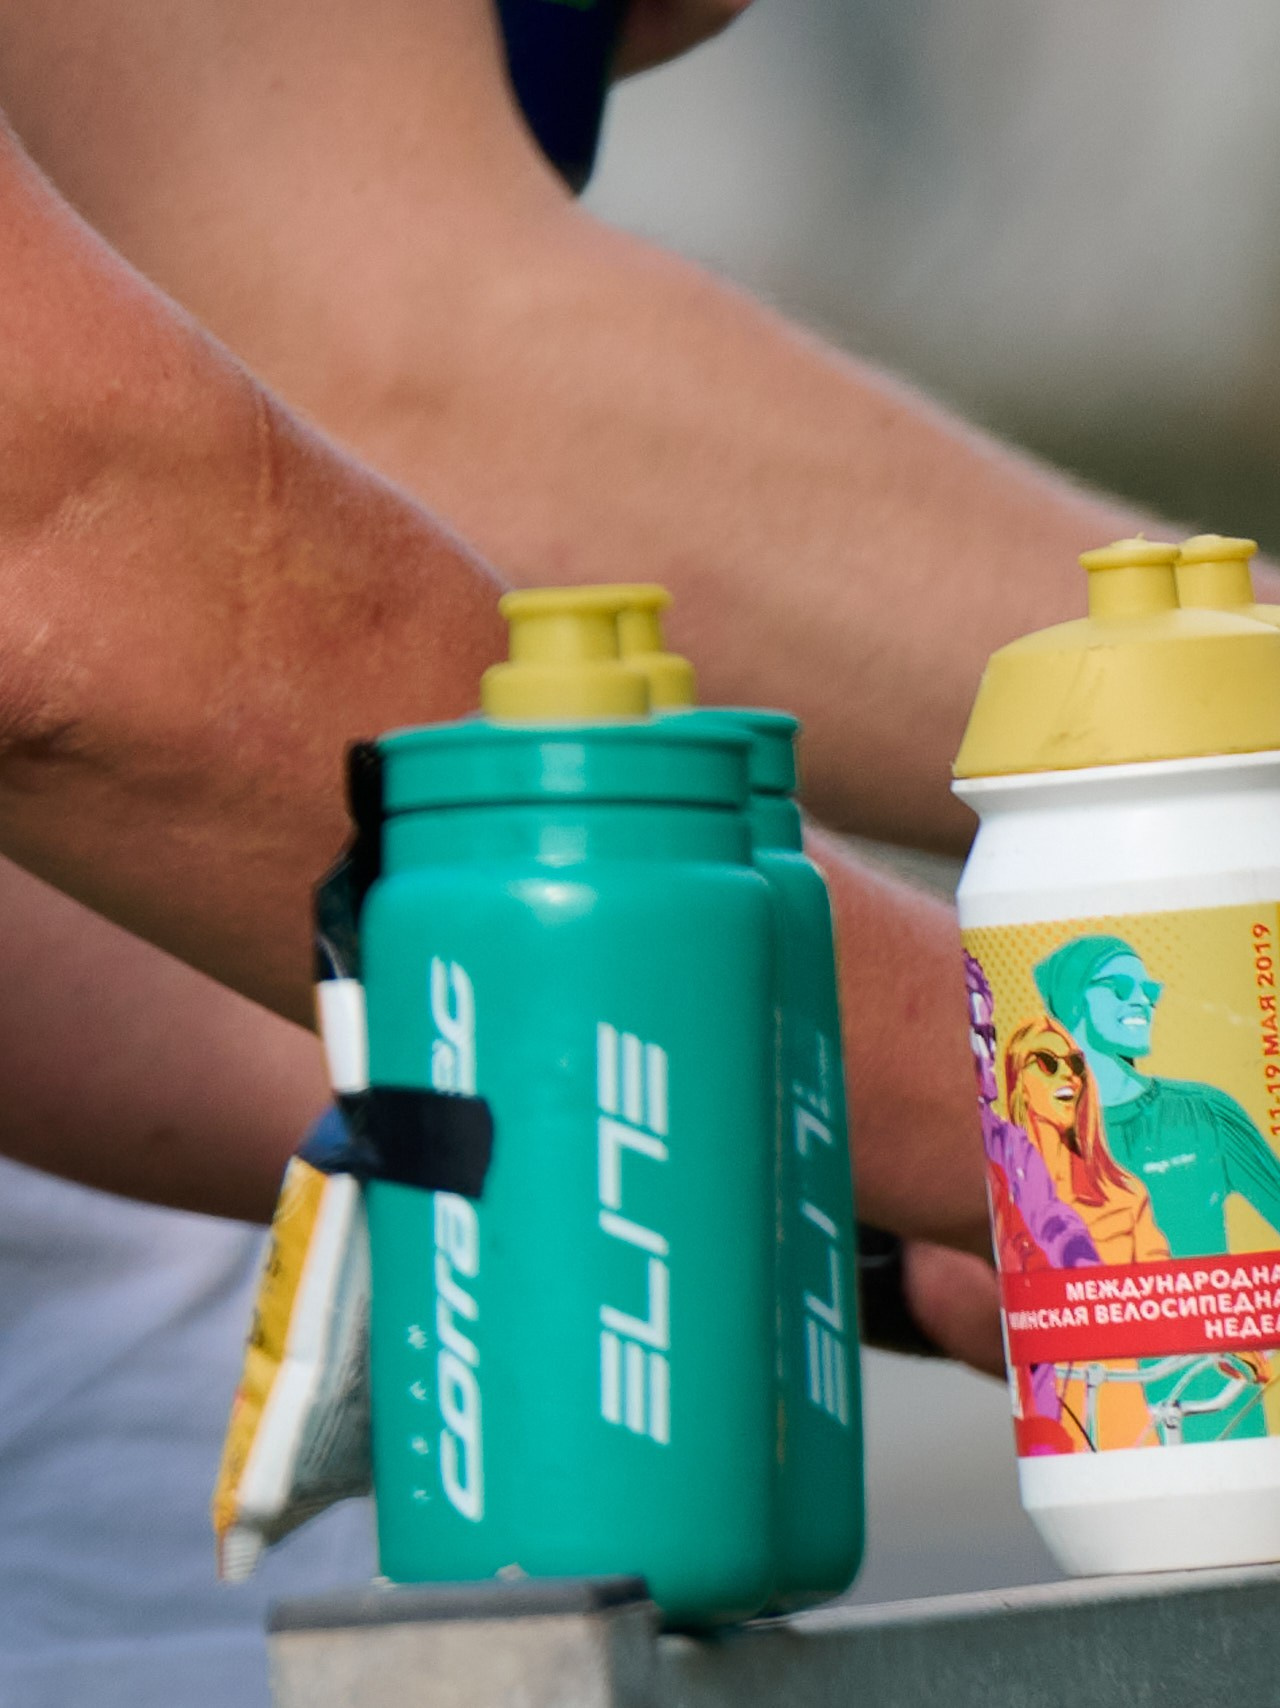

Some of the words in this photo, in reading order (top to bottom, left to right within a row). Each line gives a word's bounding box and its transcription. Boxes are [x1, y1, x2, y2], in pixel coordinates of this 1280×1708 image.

[1251, 921, 1276, 987] 2019
[1257, 994, 1280, 1057] МАЯ
[429, 954, 484, 1523] corraec
[596, 1020, 671, 1447] ELITE
